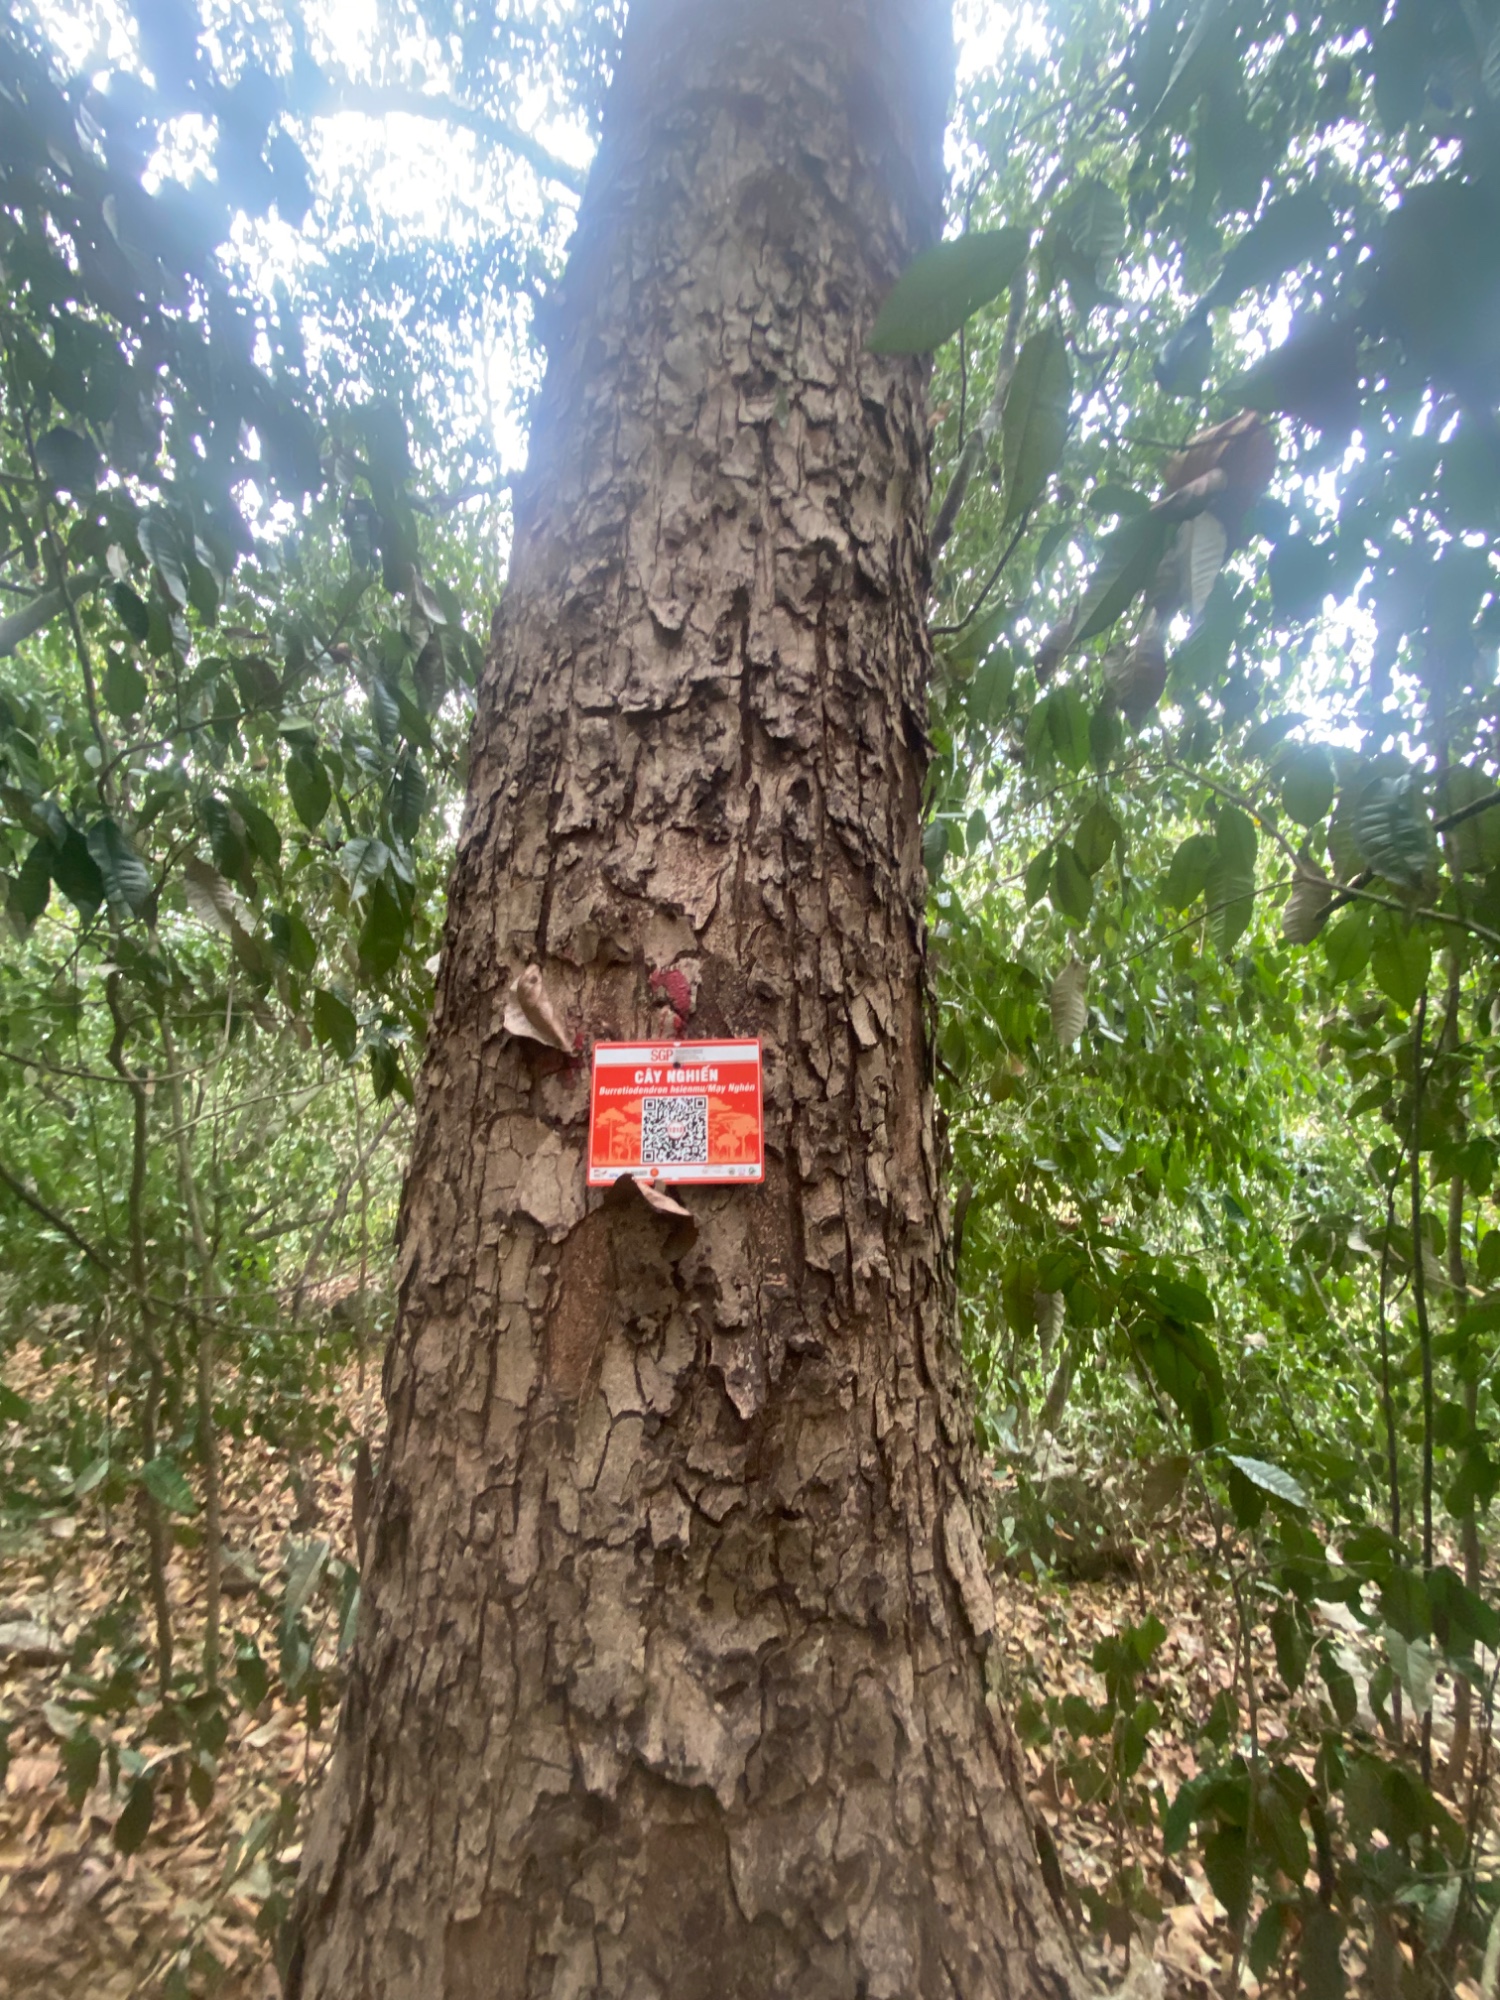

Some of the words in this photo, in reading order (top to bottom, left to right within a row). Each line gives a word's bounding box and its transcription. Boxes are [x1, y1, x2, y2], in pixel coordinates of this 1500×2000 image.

[651, 1049, 674, 1061] SGP
[634, 1067, 662, 1084] CÂY
[667, 1065, 719, 1083] NGHIẾN
